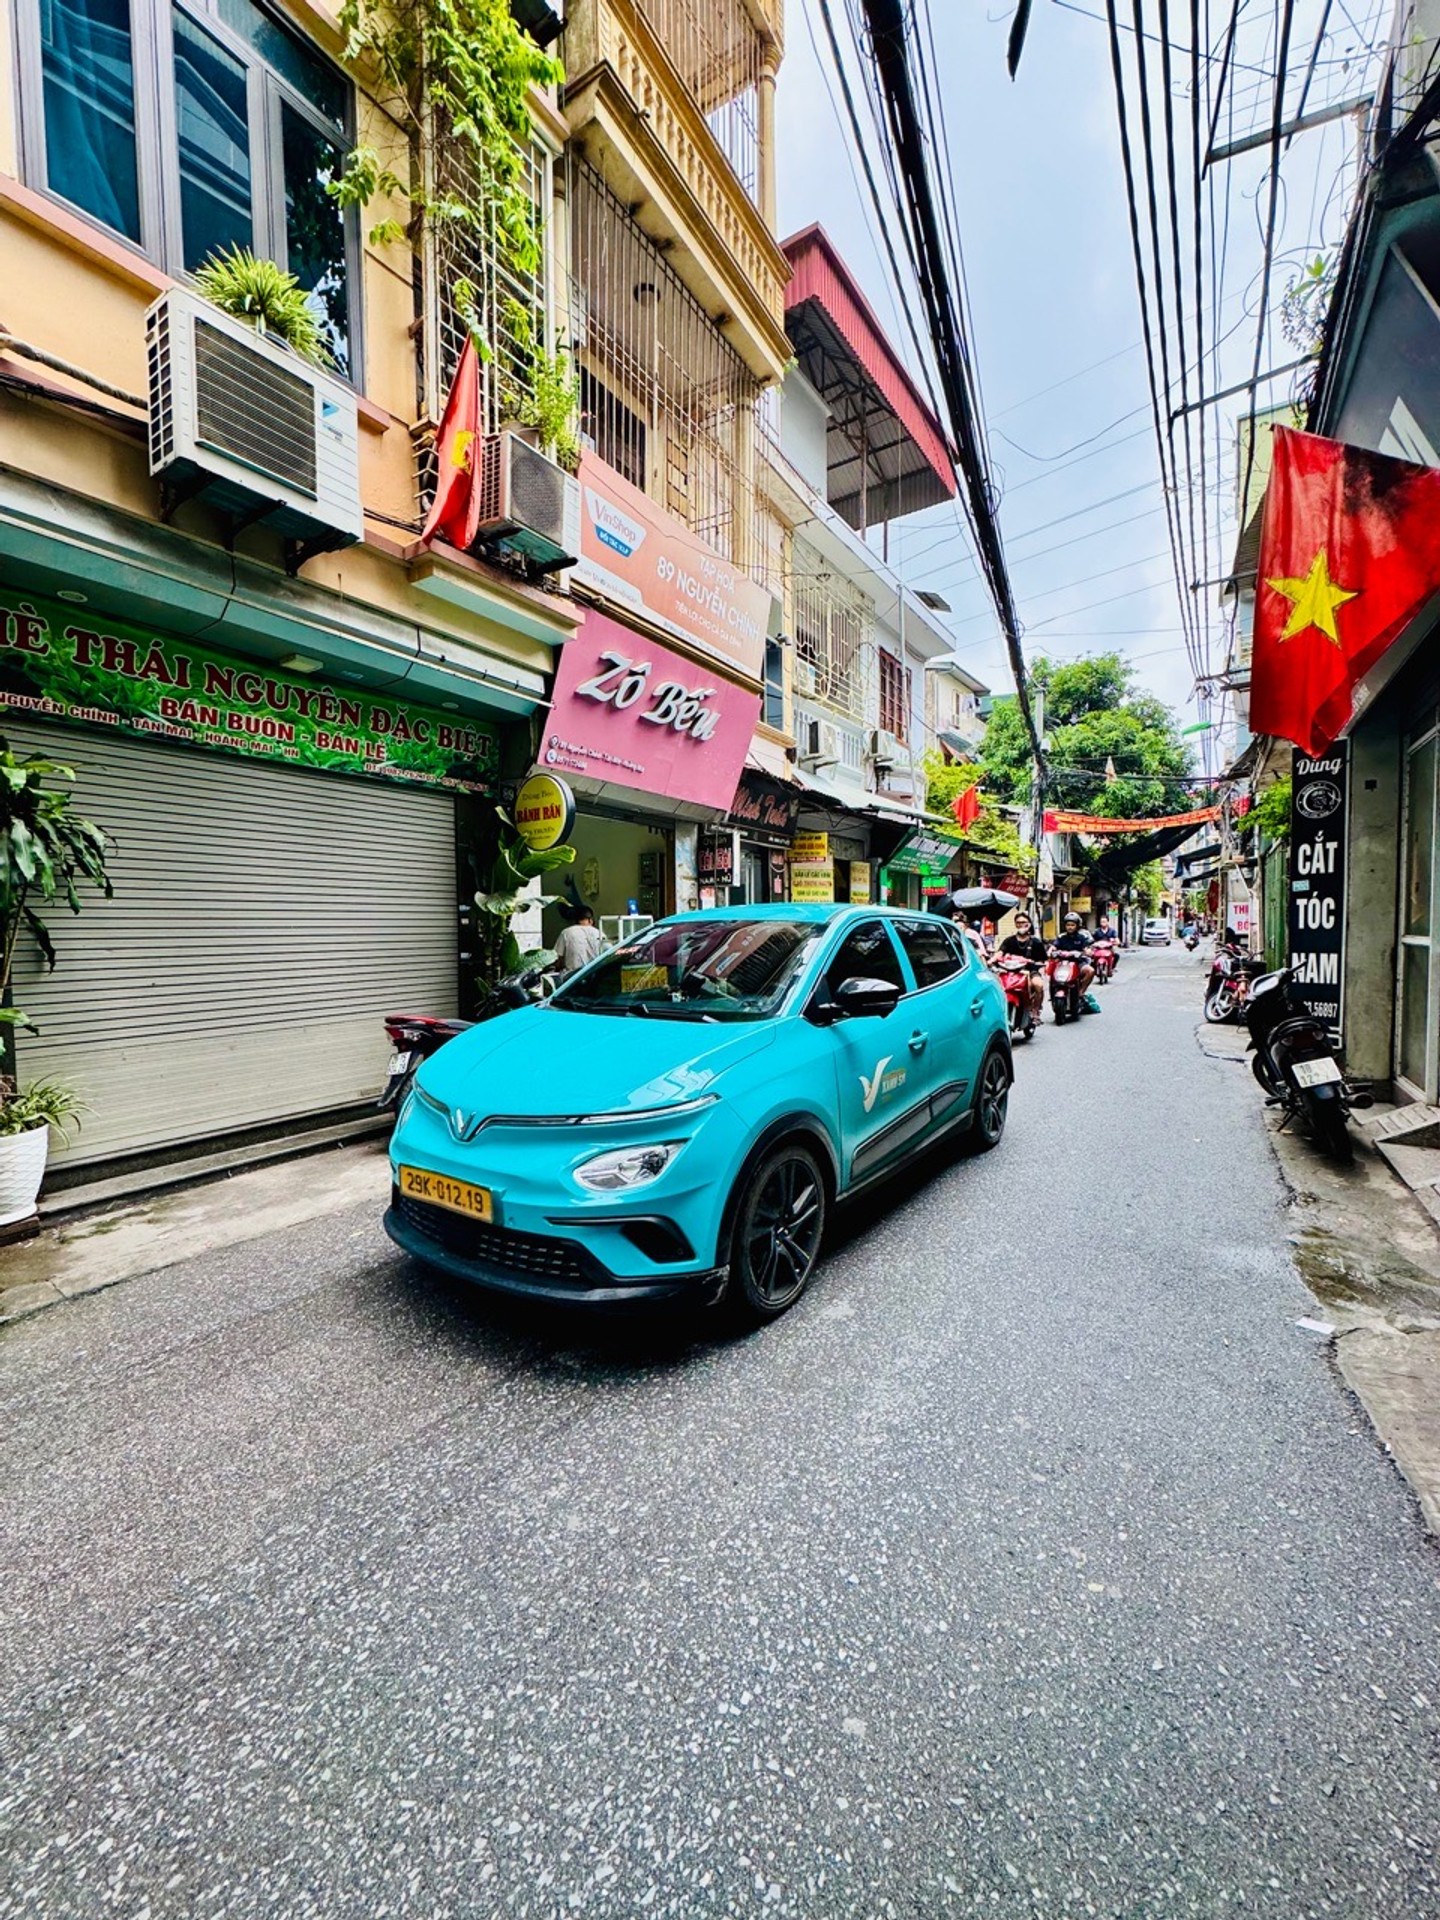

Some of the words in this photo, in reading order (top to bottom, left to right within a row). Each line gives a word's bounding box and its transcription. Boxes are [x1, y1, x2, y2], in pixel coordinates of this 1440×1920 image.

[595, 499, 636, 543] VinShop
[657, 556, 675, 582] 89
[676, 568, 727, 619] NGUYỄN
[727, 606, 761, 641] CHÍNH
[64, 625, 192, 689] THÁI
[203, 661, 362, 729] NGUYÊN
[370, 704, 430, 746] ĐẶC
[437, 723, 492, 761] BIỆT
[639, 681, 721, 741] Bếu
[69, 705, 120, 725] CHÍNH
[132, 716, 161, 733] TÂN
[164, 725, 193, 739] MAI
[250, 742, 275, 754] MAI
[284, 747, 299, 758] HN
[160, 697, 219, 727] BÁN
[227, 711, 294, 743] BUÔN
[315, 731, 359, 755] BÁN
[364, 737, 387, 761] LẺ
[516, 806, 540, 824] BÁNH
[542, 803, 561, 820] RÁN
[1297, 830, 1338, 875] CẮT
[1296, 891, 1335, 930] TÓC
[1291, 952, 1338, 985] NAM
[407, 1172, 484, 1213] 29K-012.19
